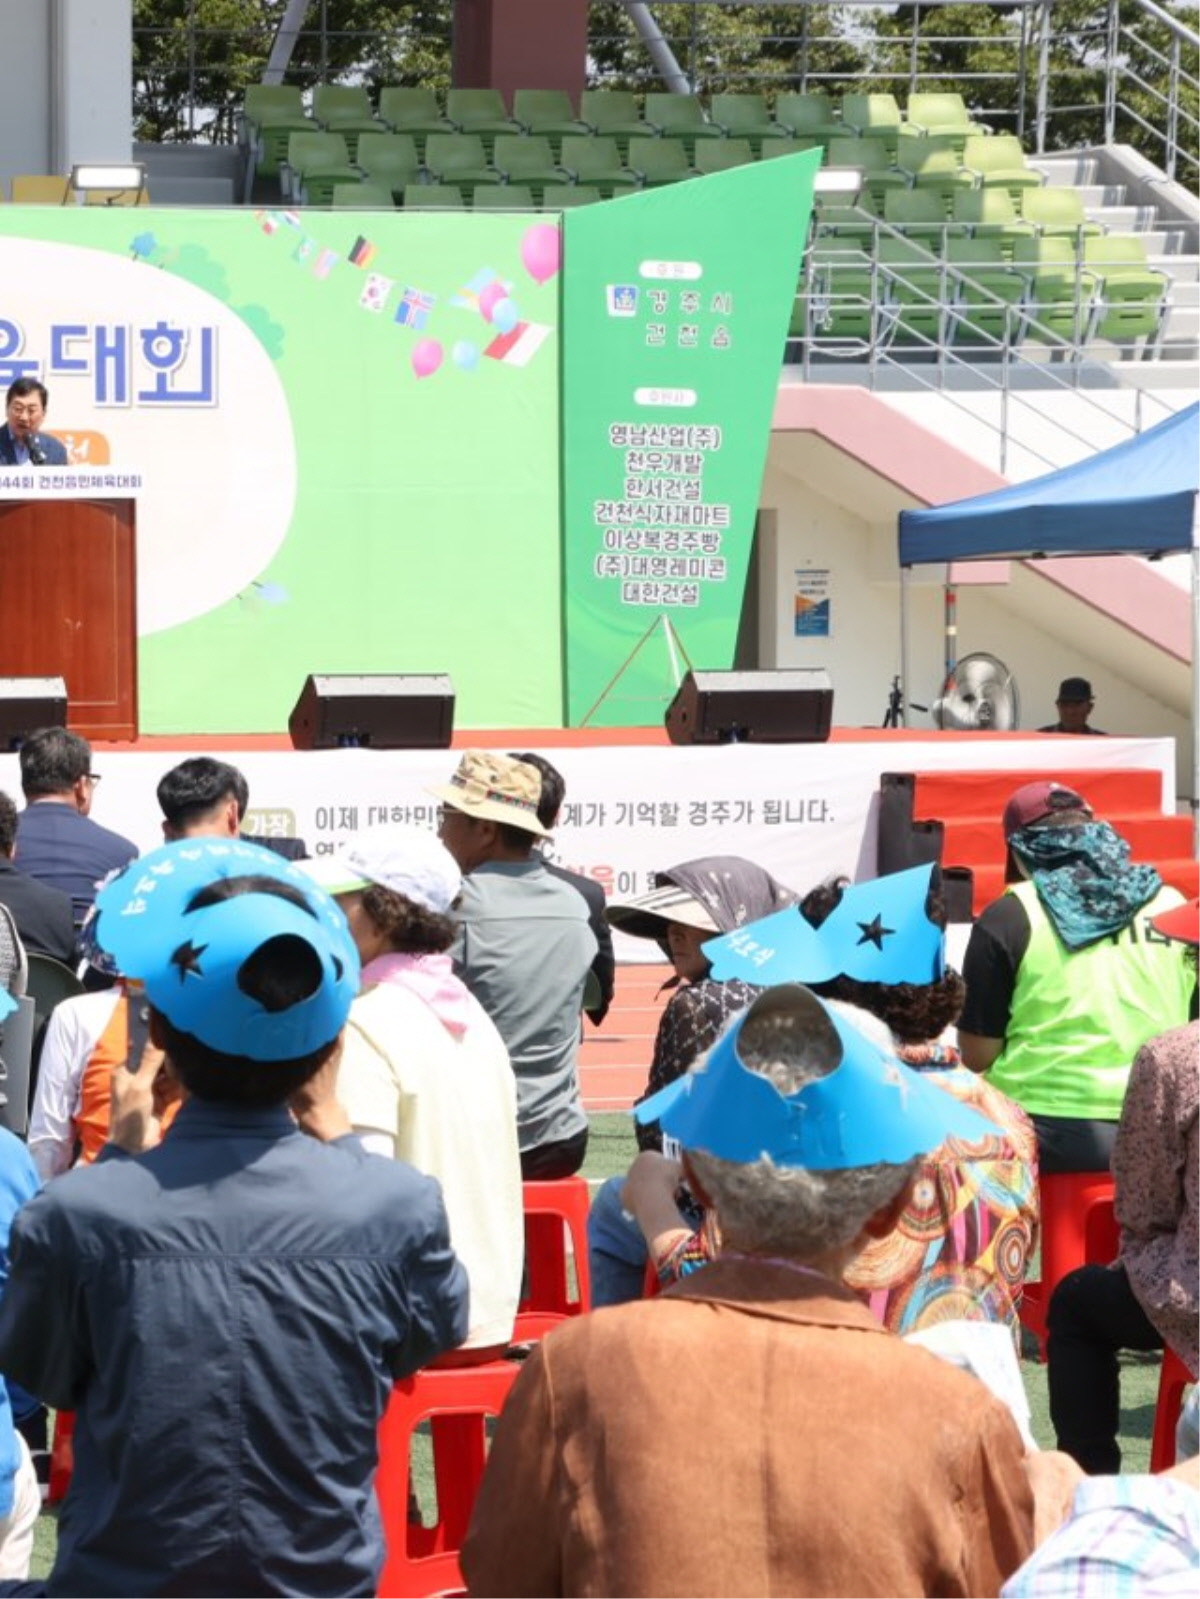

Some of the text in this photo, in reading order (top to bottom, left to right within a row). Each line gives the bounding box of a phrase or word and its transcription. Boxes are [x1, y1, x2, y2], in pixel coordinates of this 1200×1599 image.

[610, 424, 720, 449] 영남산업(주)
[626, 451, 703, 475] 천우개발
[625, 478, 701, 501] 한서건설
[596, 503, 729, 526] 건천식자재마트
[604, 529, 720, 553] 이상복경주빵
[596, 555, 725, 580] (주)대영레미콘
[623, 583, 698, 605] 대한건설
[315, 799, 835, 831] 이제 대한민 계가 기억할 경주가 됩니다.
